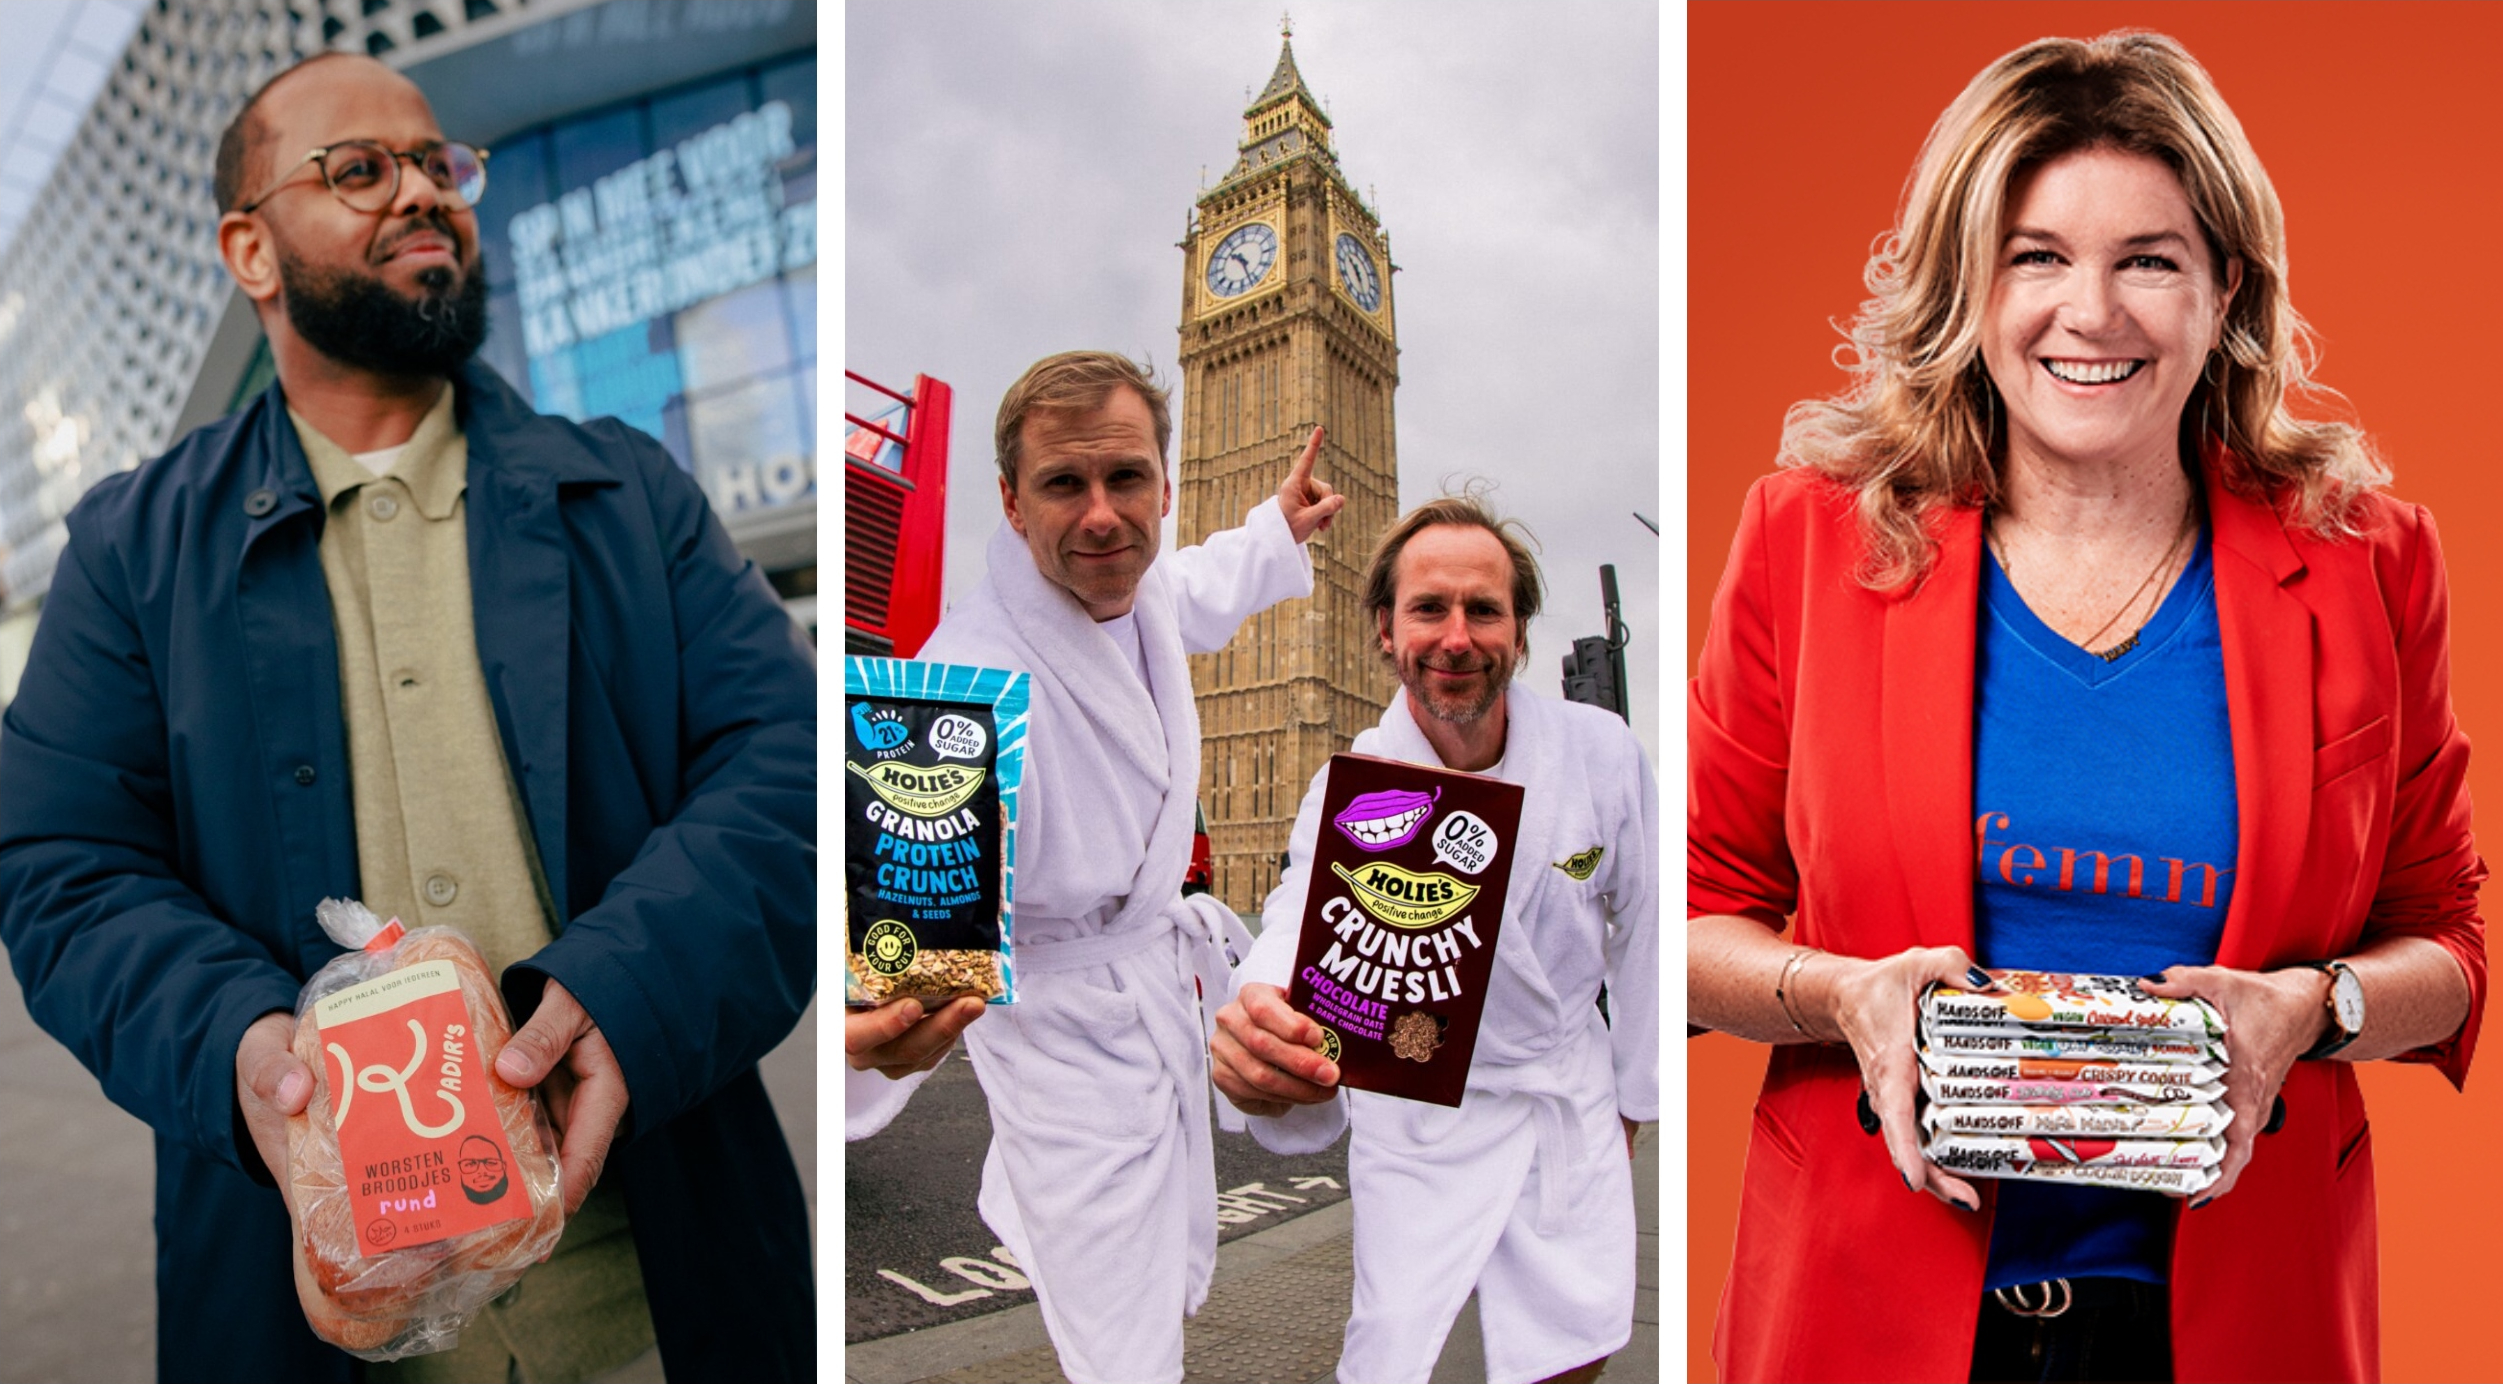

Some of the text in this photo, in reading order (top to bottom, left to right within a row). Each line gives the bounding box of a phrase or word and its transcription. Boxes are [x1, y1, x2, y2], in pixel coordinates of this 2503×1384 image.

[876, 739, 915, 760] PROTEIN
[934, 739, 976, 757] SUGAR
[950, 735, 980, 748] ADDED
[881, 766, 965, 793] HOLIE'S
[892, 793, 960, 809] positive change
[866, 800, 981, 842] GRANOLA
[874, 832, 981, 867] PROTEIN
[1436, 838, 1478, 872] SUGAR
[1455, 840, 1485, 863] ADDED
[877, 862, 980, 894] CRUNCH
[1366, 868, 1454, 902] HOLIE'S
[940, 891, 982, 907] ALMONDS
[1372, 899, 1443, 920] positive change
[912, 909, 952, 920] & SEEDS
[867, 924, 911, 946] GOOD FOR
[1320, 895, 1483, 968] CRUNCHY
[868, 951, 891, 972] YOUR
[1318, 940, 1463, 1004] MUESLI
[328, 969, 441, 1012] HAPPY HALAL VOOR IEDEREEN
[1301, 965, 1390, 1021] CHOCOLATE
[1308, 1001, 1383, 1042] & DARK CHOCOLATE
[1312, 992, 1386, 1031] WHOLEGRAIN OATS
[1325, 1032, 1338, 1049] FOR
[365, 1149, 444, 1180] WORSTEN
[362, 1167, 451, 1197] BROODJES
[379, 1188, 437, 1216] rund
